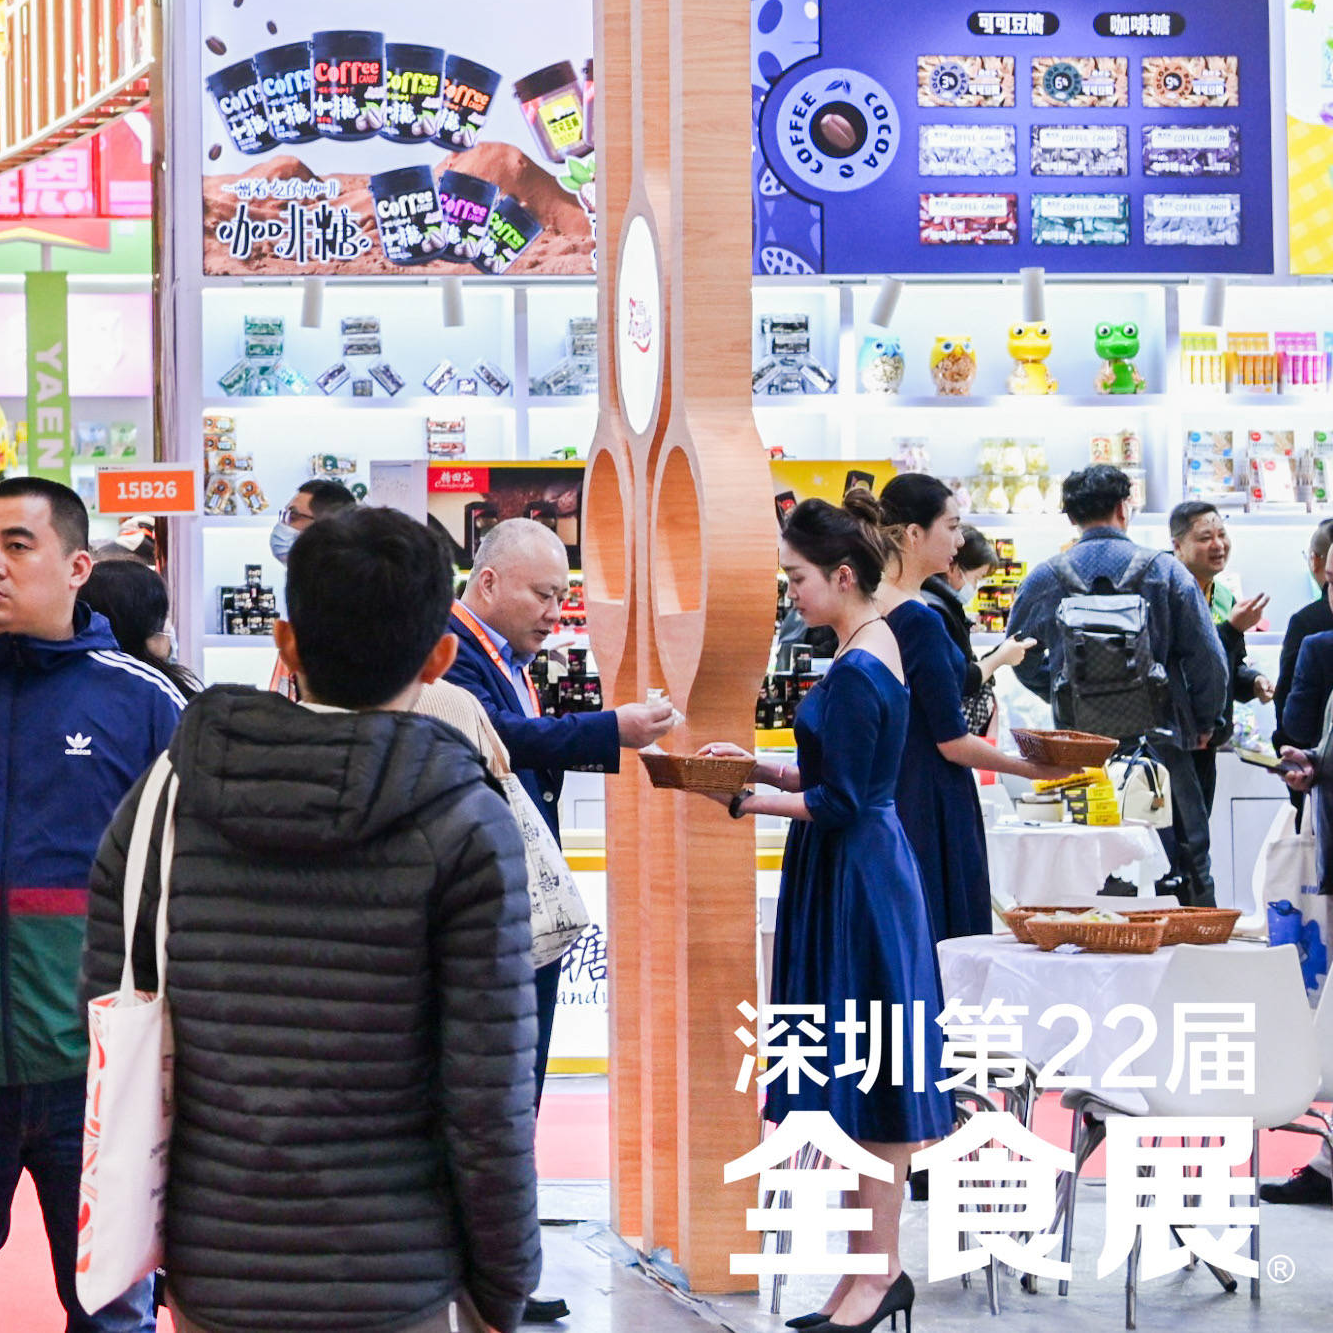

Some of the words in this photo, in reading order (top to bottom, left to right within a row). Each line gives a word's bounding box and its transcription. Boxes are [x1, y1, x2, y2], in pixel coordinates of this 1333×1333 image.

[789, 91, 824, 174] COFFEE
[864, 92, 892, 168] COCOA
[35, 341, 64, 471] YAEN
[117, 480, 178, 500] 15B26
